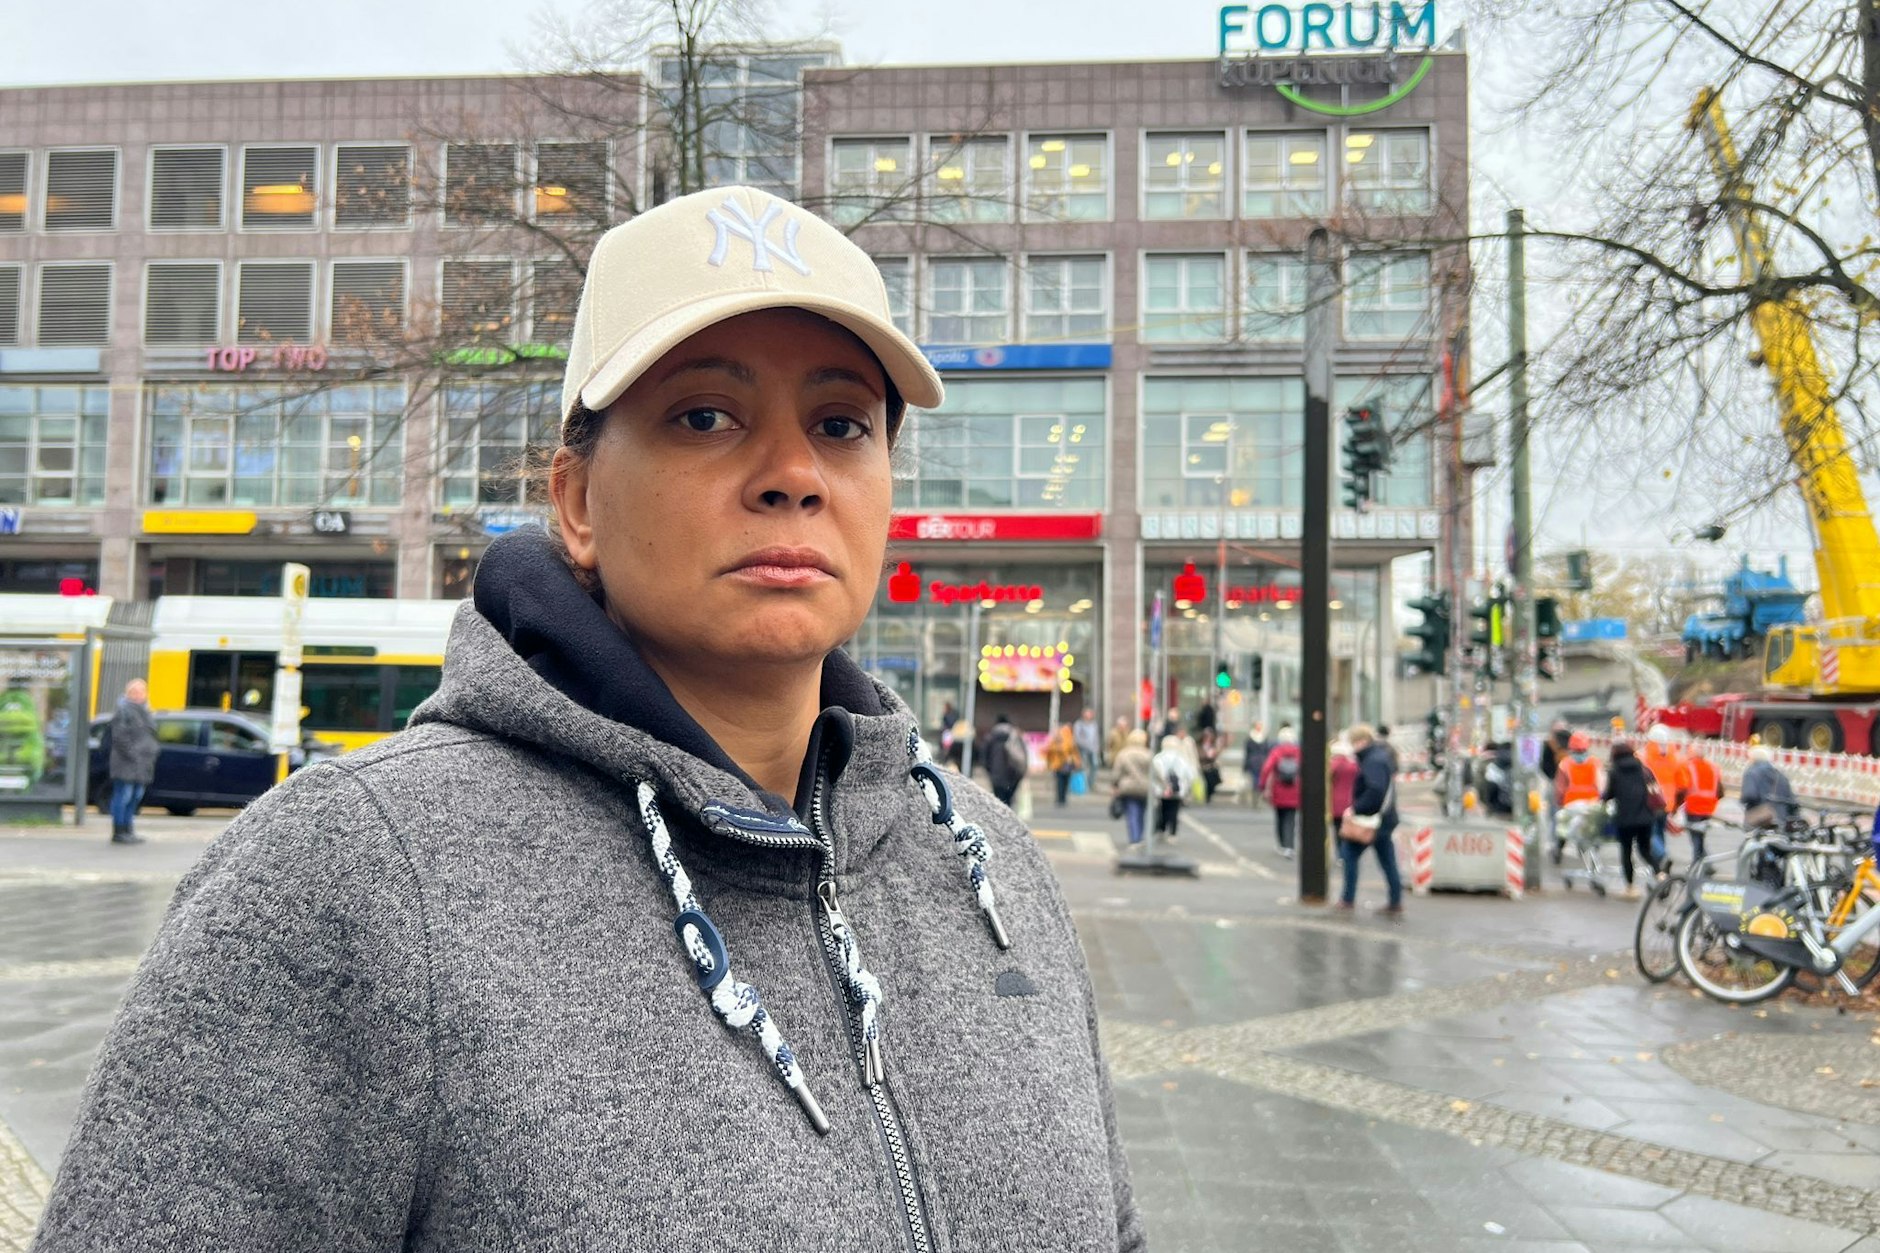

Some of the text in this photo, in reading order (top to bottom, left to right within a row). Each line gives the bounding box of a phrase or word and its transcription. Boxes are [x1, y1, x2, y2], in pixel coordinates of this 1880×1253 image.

[1219, 0, 1435, 52] FORUM
[705, 195, 812, 277] NY
[207, 346, 328, 371] TOP TWO
[929, 581, 1043, 606] Sparkasse
